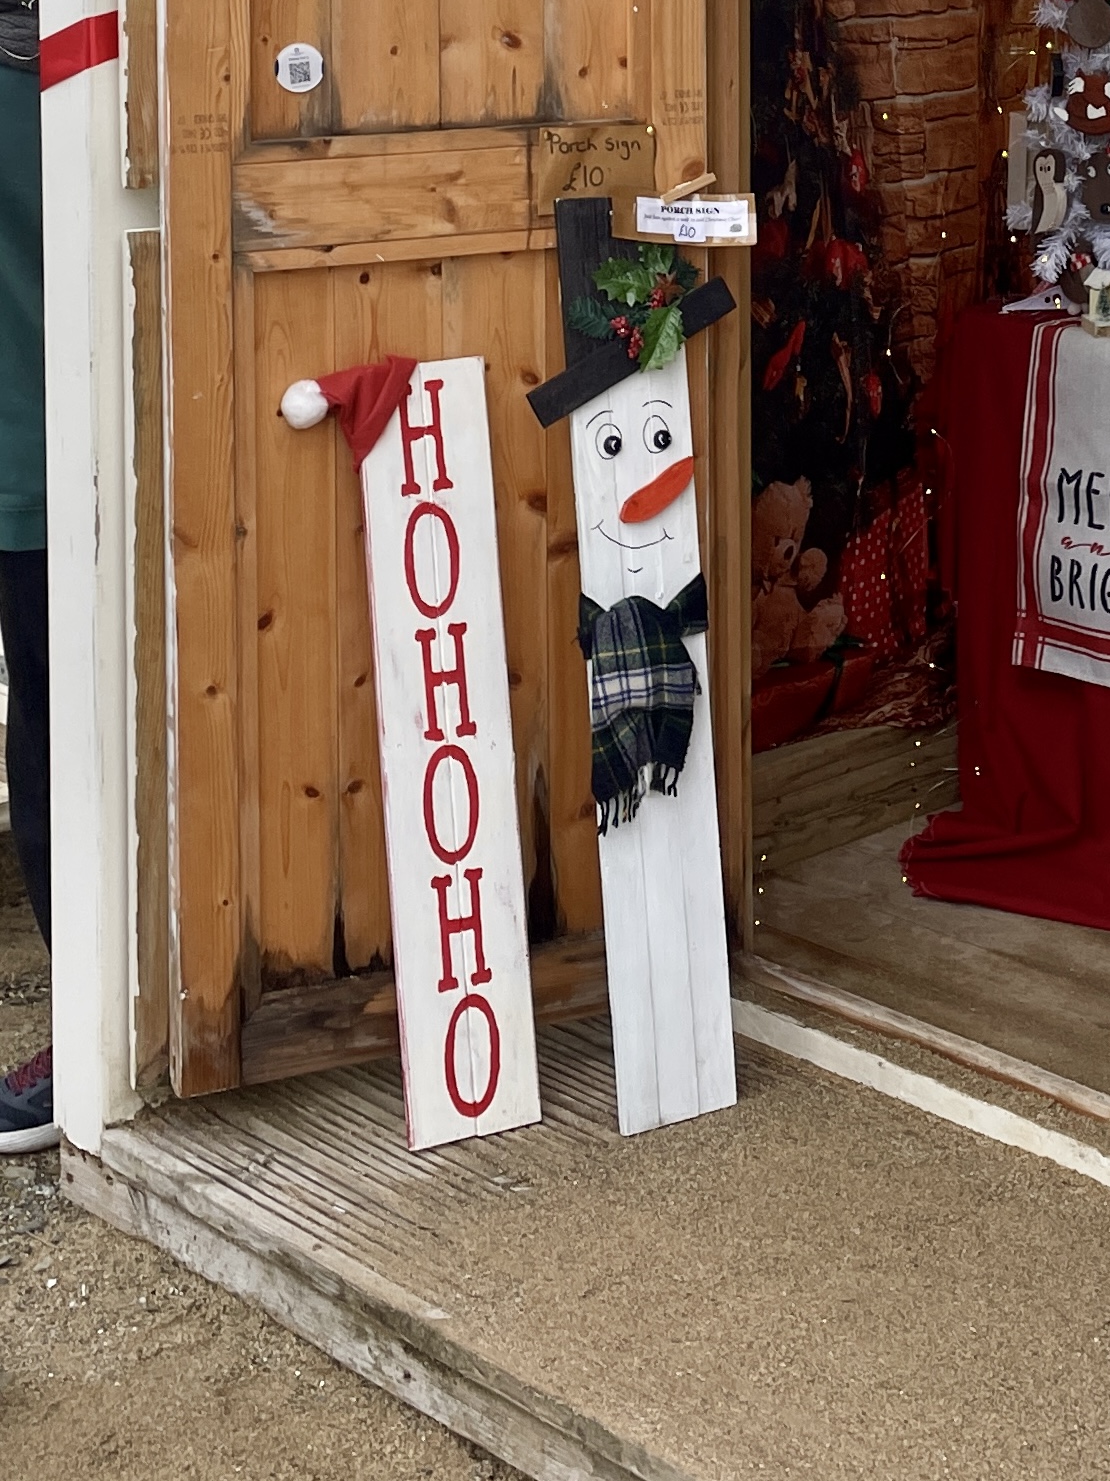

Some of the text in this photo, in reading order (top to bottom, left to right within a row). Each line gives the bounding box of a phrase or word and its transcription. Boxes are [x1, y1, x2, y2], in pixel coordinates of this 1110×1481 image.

[549, 133, 597, 154] Porch
[562, 162, 604, 191] £10
[661, 205, 720, 215] PORCH SIGN
[679, 224, 696, 238] £10
